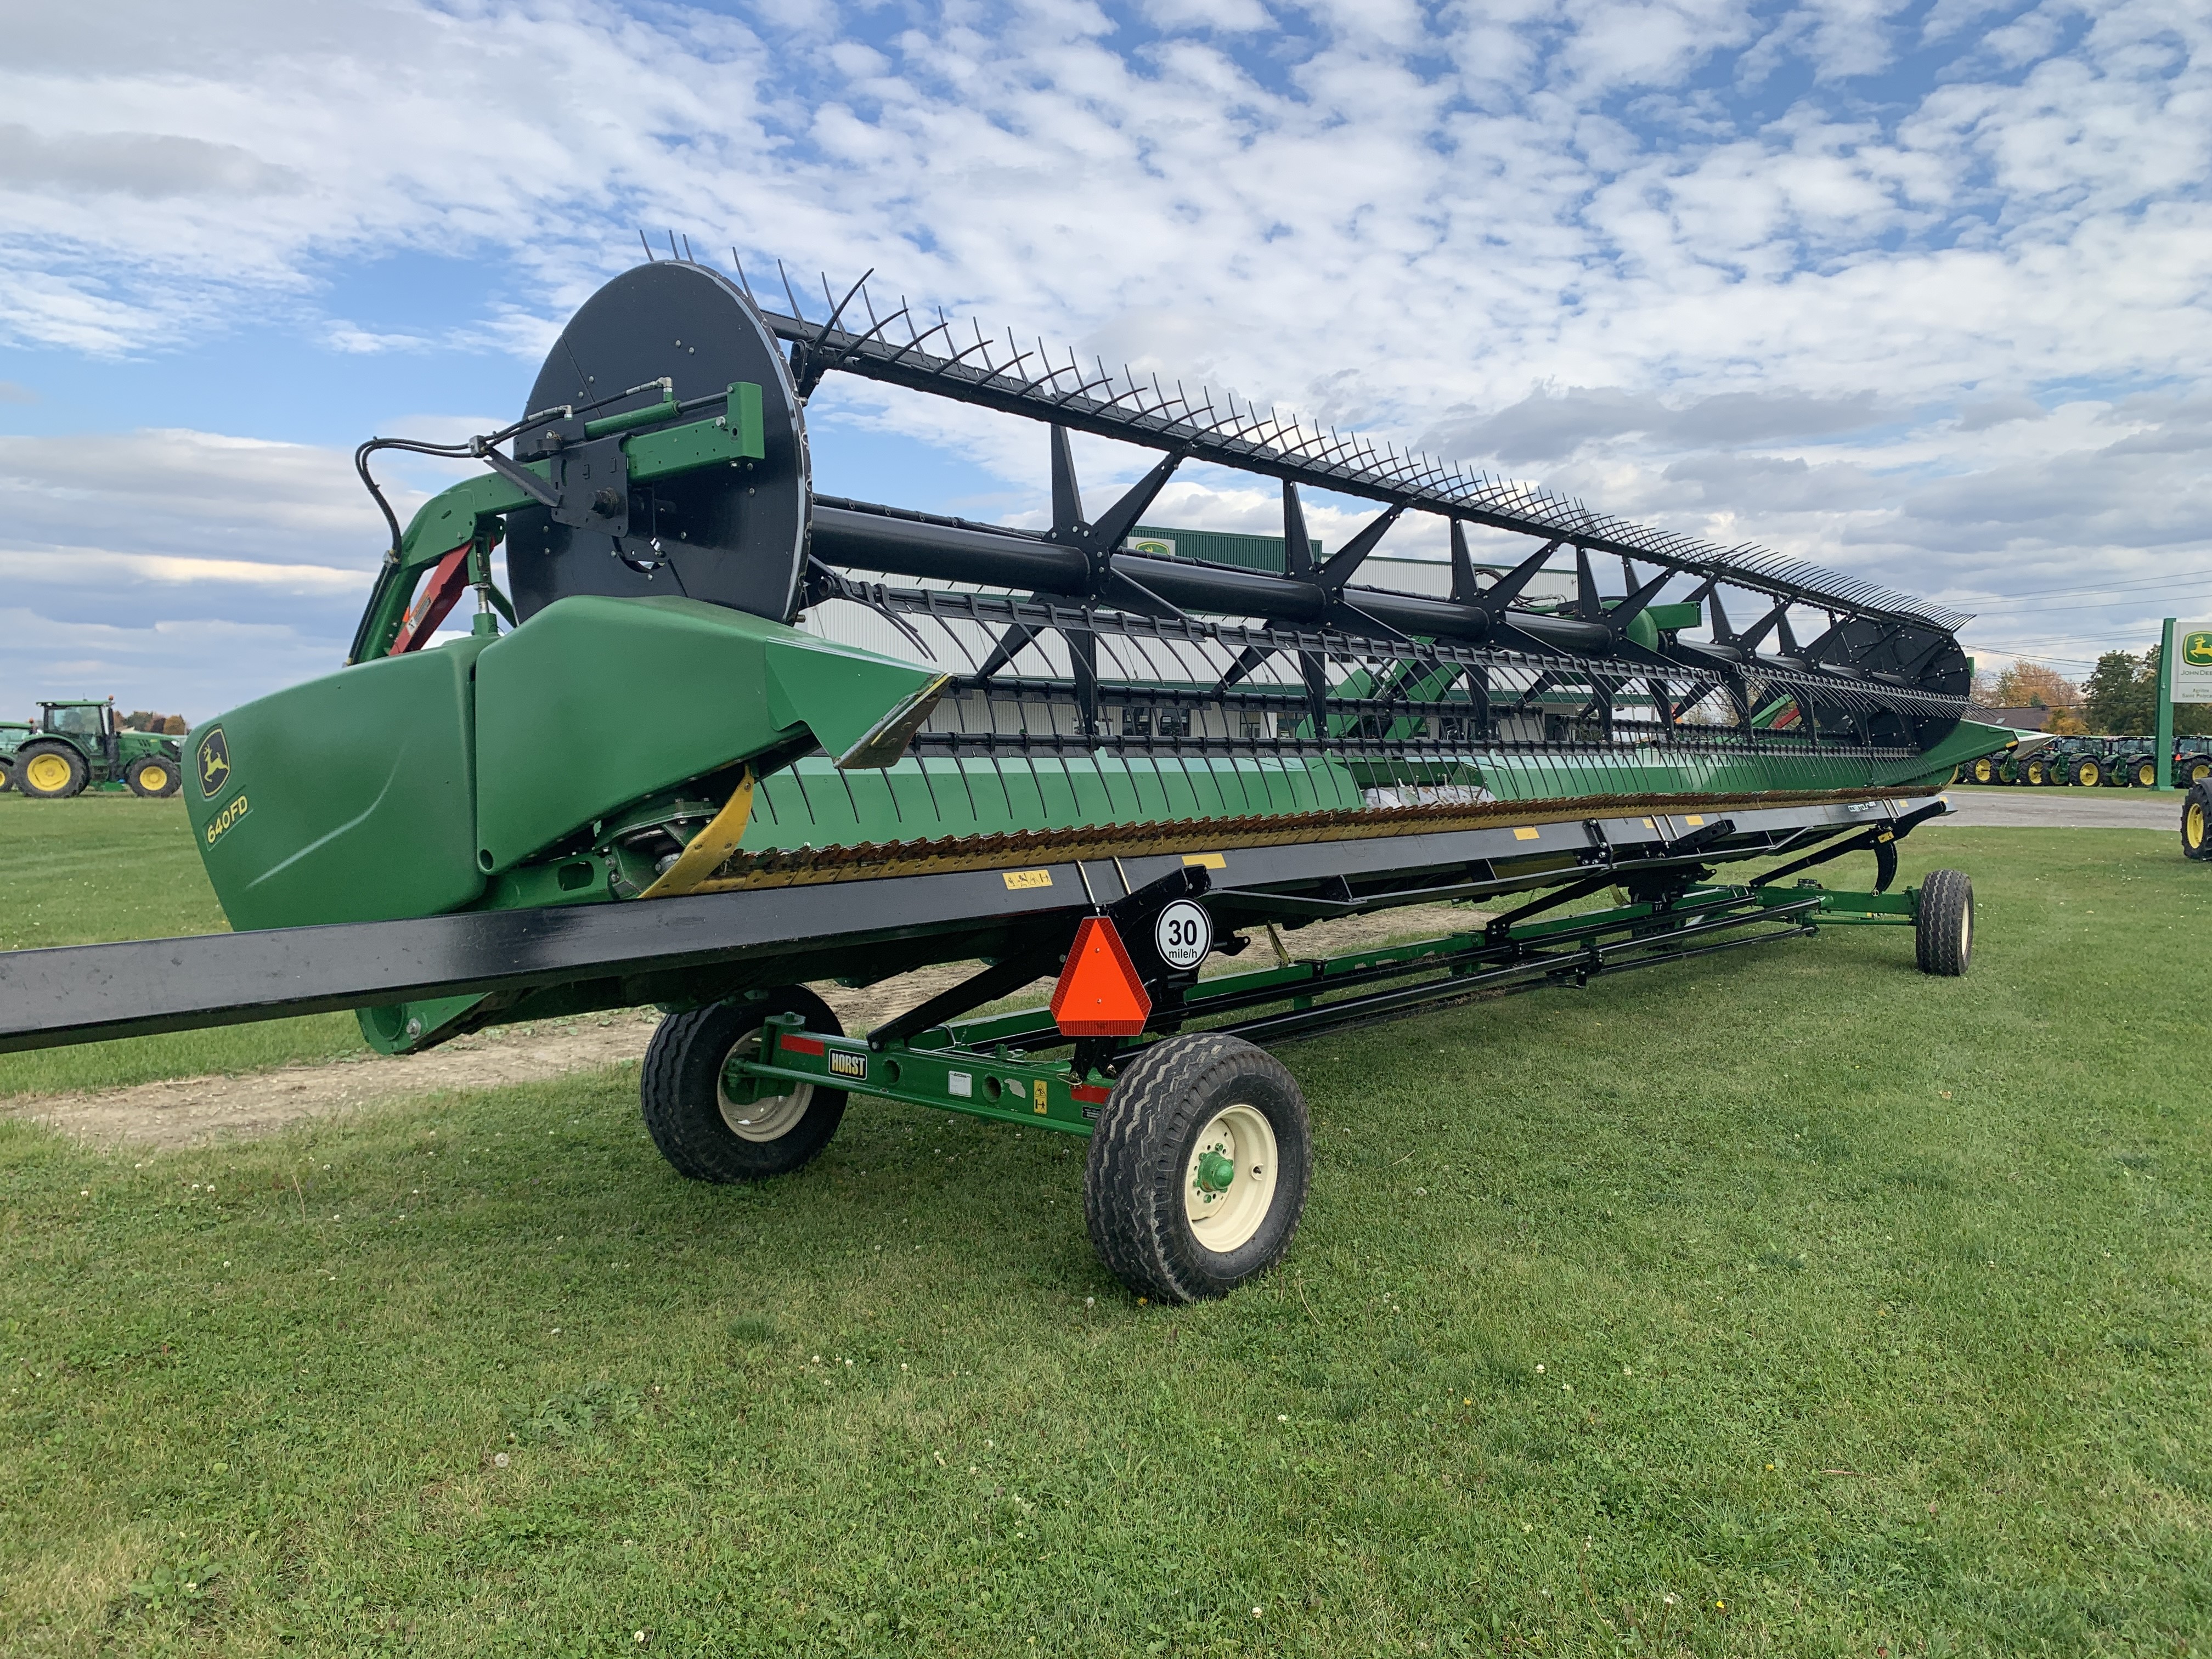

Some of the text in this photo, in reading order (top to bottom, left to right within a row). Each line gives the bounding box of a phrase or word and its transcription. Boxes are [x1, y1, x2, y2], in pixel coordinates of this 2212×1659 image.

[207, 795, 248, 843] 640FD
[1169, 919, 1197, 946] 30
[1169, 949, 1197, 958] mile/h
[832, 1053, 865, 1076] HORST
